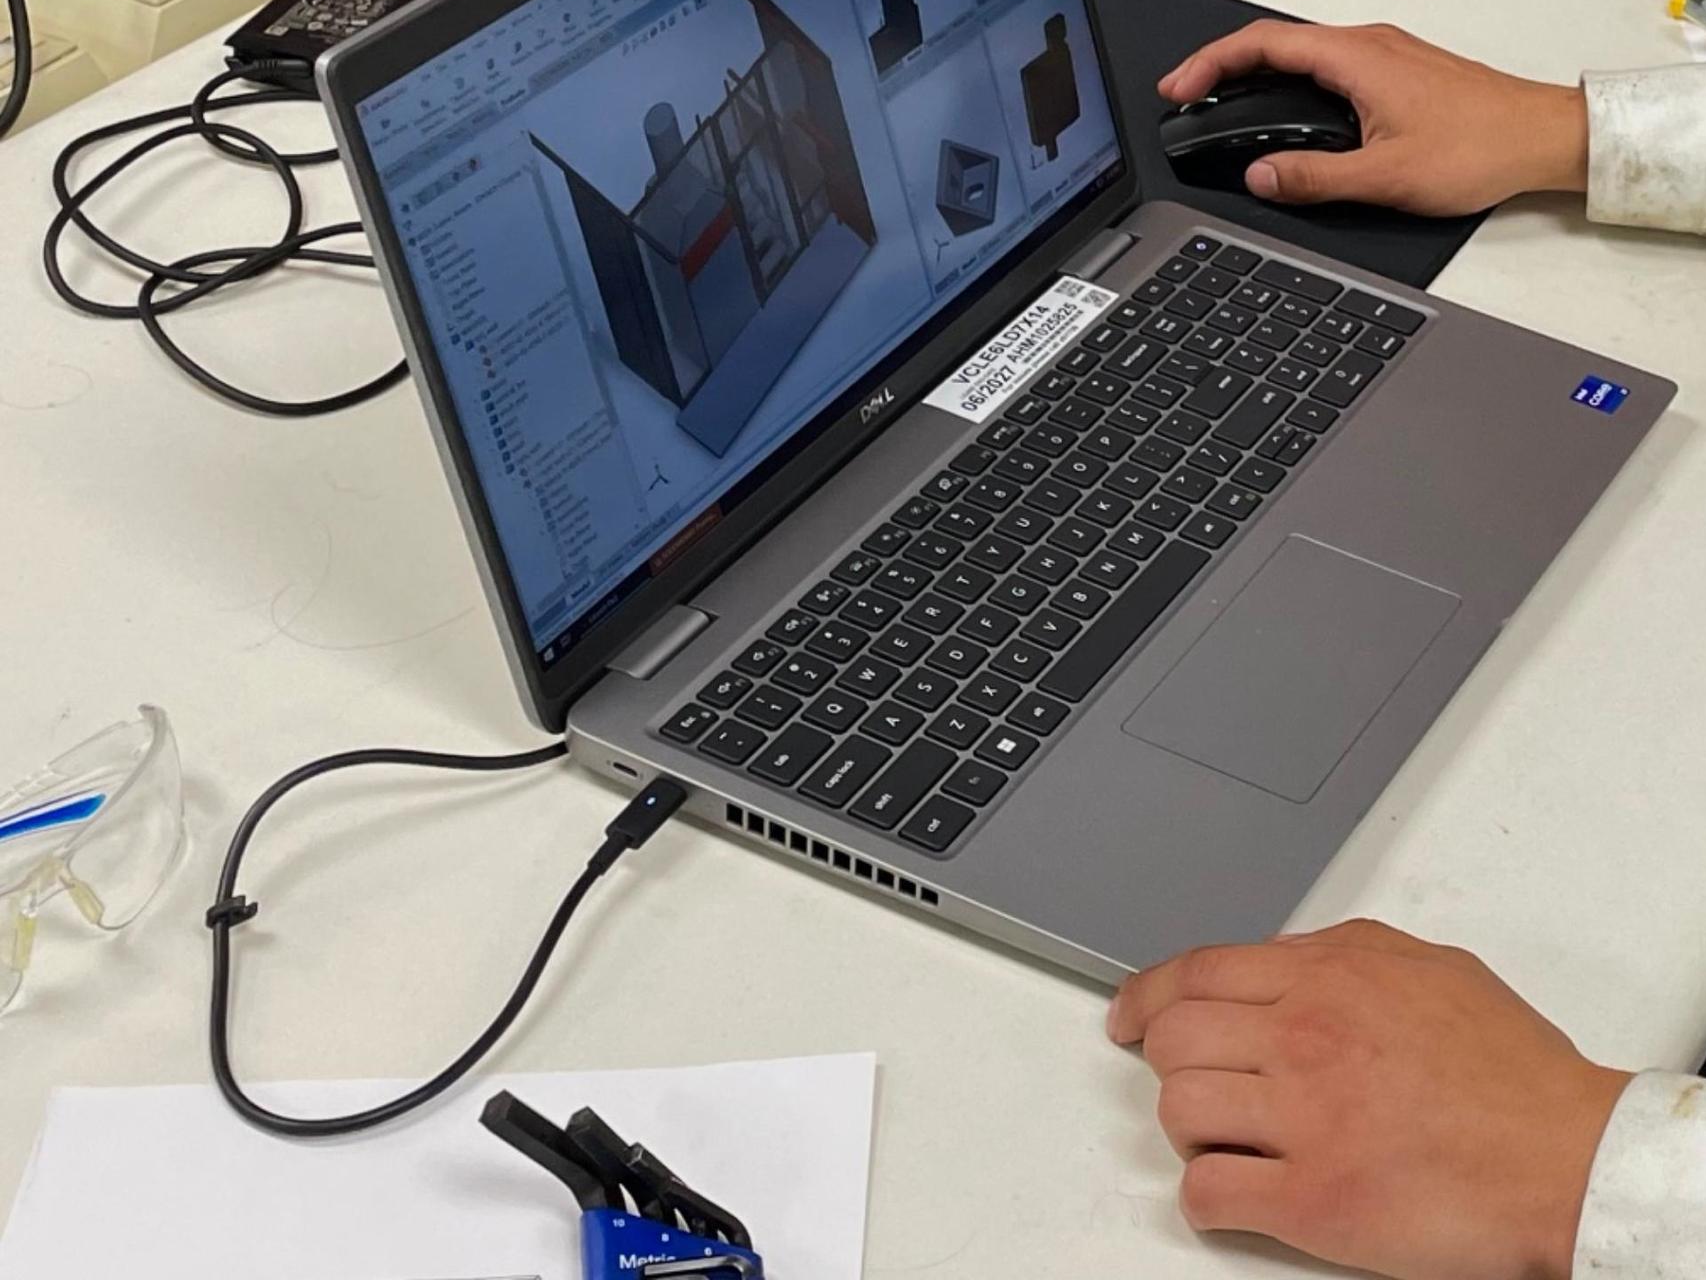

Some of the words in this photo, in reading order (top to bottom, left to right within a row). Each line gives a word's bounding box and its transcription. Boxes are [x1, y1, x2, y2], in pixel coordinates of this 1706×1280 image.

[1302, 341, 1314, 349] 2
[860, 387, 896, 424] DELL
[960, 365, 1016, 413] 06/2027
[826, 702, 843, 713] Q
[858, 667, 875, 680] W
[893, 637, 908, 647] E
[924, 606, 940, 616] R
[955, 575, 969, 584] T
[986, 545, 999, 554] Y
[1015, 517, 1030, 527] U
[1072, 462, 1087, 471] O
[1099, 435, 1110, 445] P
[803, 670, 817, 679] 2
[837, 637, 851, 645] 3
[873, 606, 883, 614] 4
[902, 575, 915, 583] 5
[934, 546, 946, 554] 6
[963, 517, 975, 525] 7
[885, 716, 900, 726] A
[917, 682, 932, 692] S
[948, 649, 963, 660] D
[979, 617, 991, 627] F
[1011, 586, 1026, 597] G
[1040, 557, 1055, 568] H
[1071, 528, 1084, 538] J
[1097, 500, 1110, 510] K
[949, 718, 965, 730] Z
[981, 685, 997, 696] X
[1012, 652, 1028, 663] C
[1042, 620, 1057, 630] V
[1072, 591, 1087, 602] B
[1100, 561, 1116, 572] N
[1127, 531, 1143, 544] M
[612, 1218, 626, 1228] 10
[660, 1233, 671, 1243] 8
[703, 1246, 713, 1257] 6
